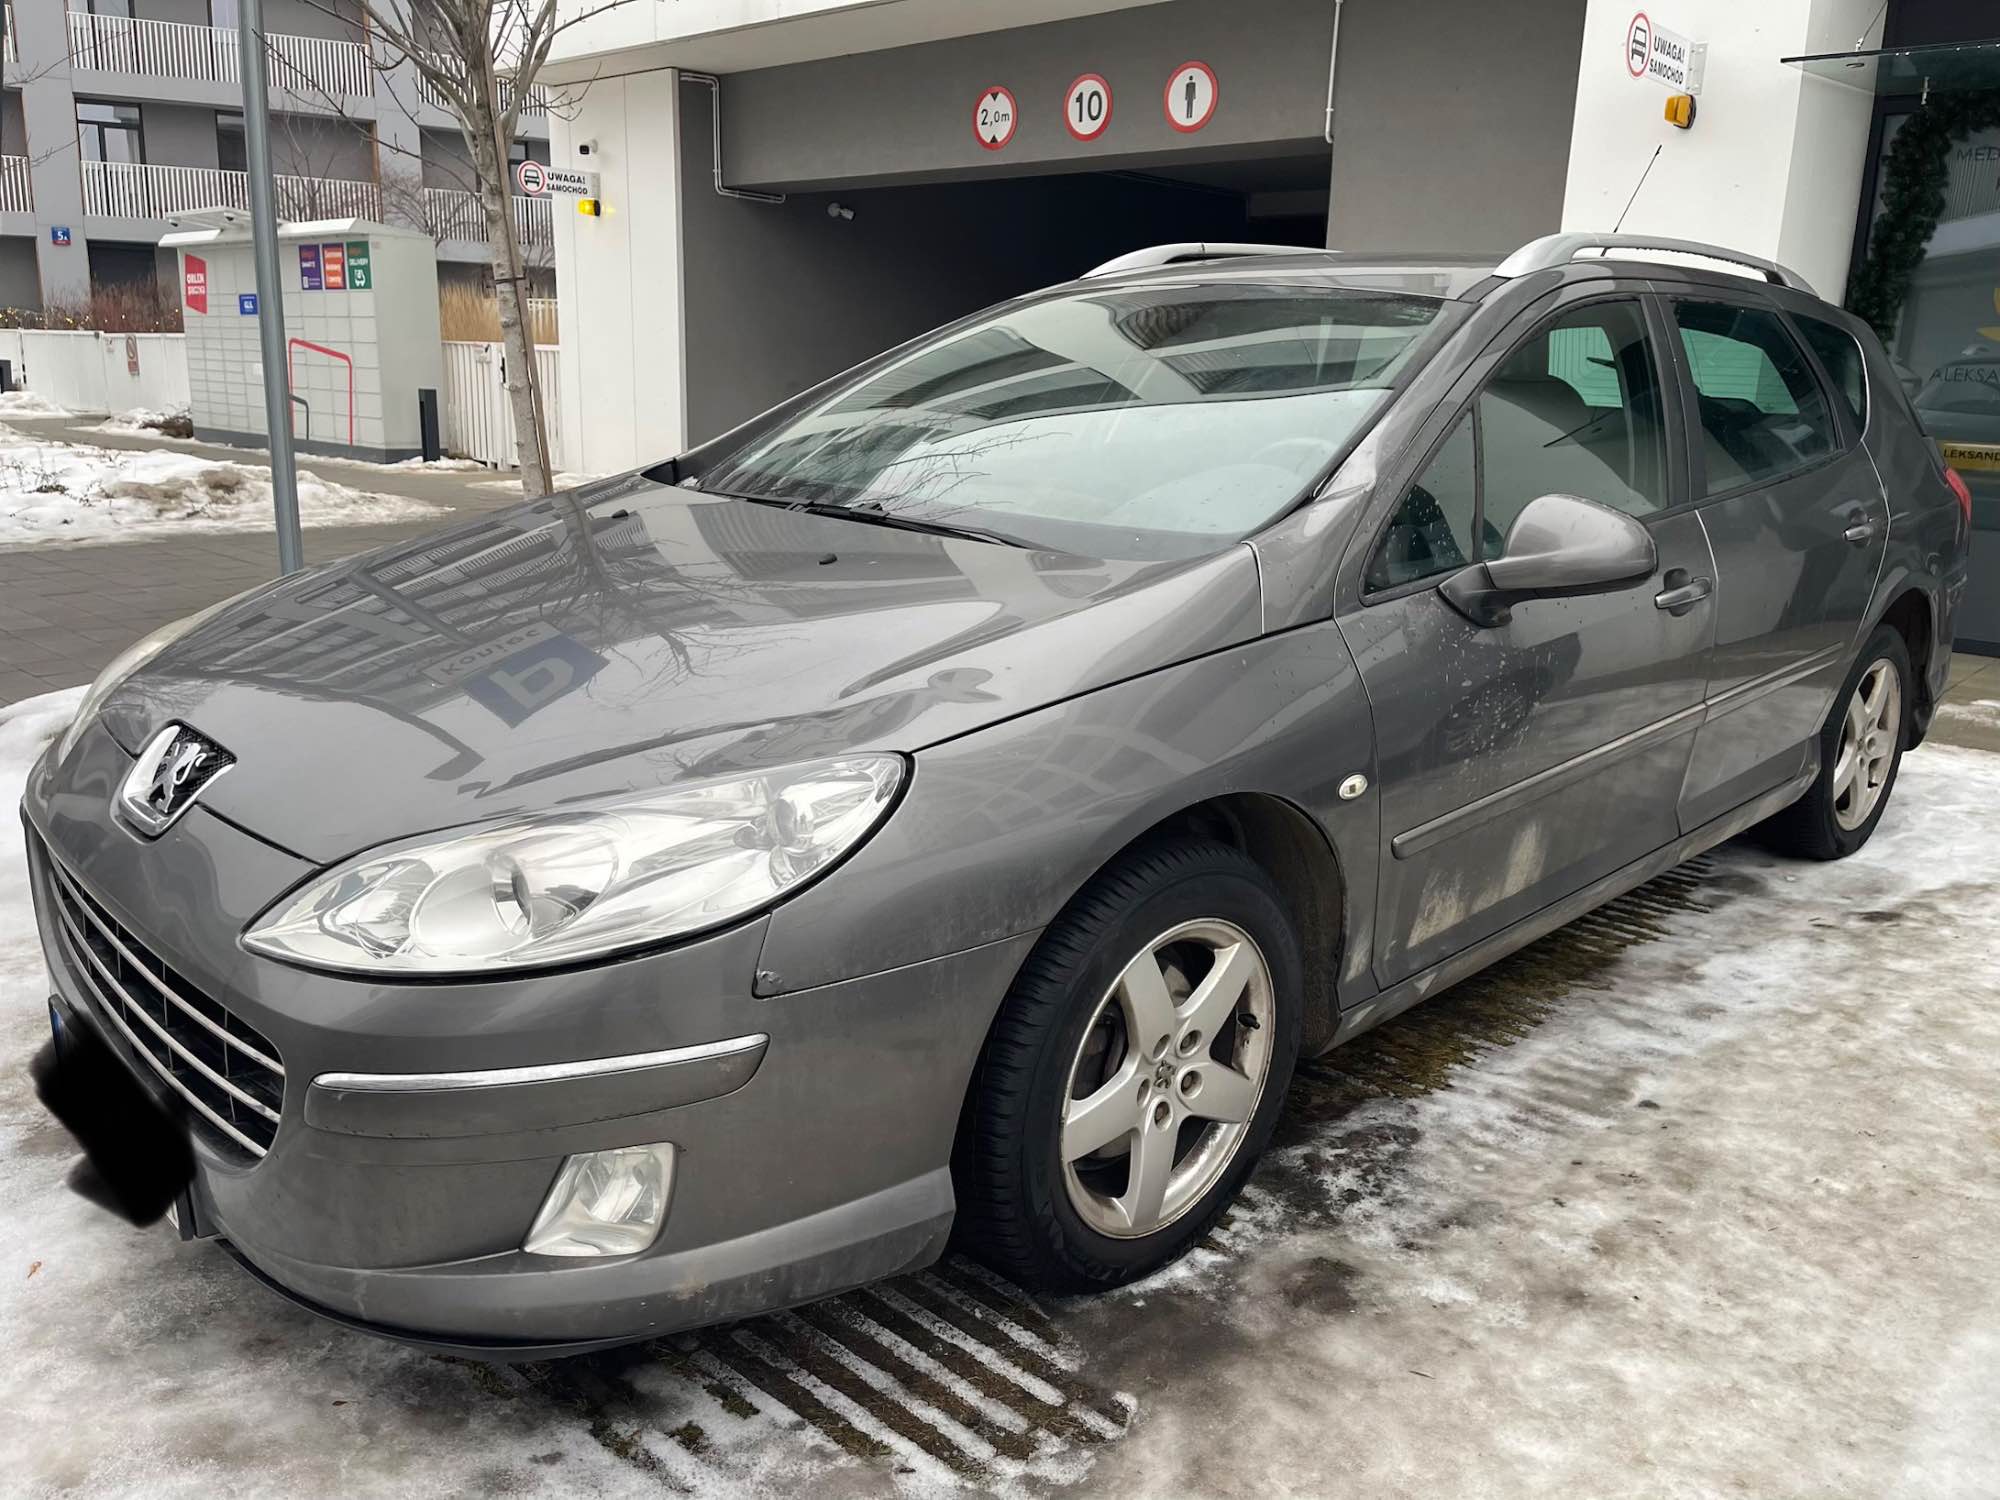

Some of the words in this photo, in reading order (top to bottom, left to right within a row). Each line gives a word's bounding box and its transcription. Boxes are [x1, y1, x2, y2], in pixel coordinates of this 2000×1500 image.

[1653, 35, 1686, 64] UWAGA!
[1075, 90, 1103, 122] 10
[547, 172, 586, 185] UWAGA!
